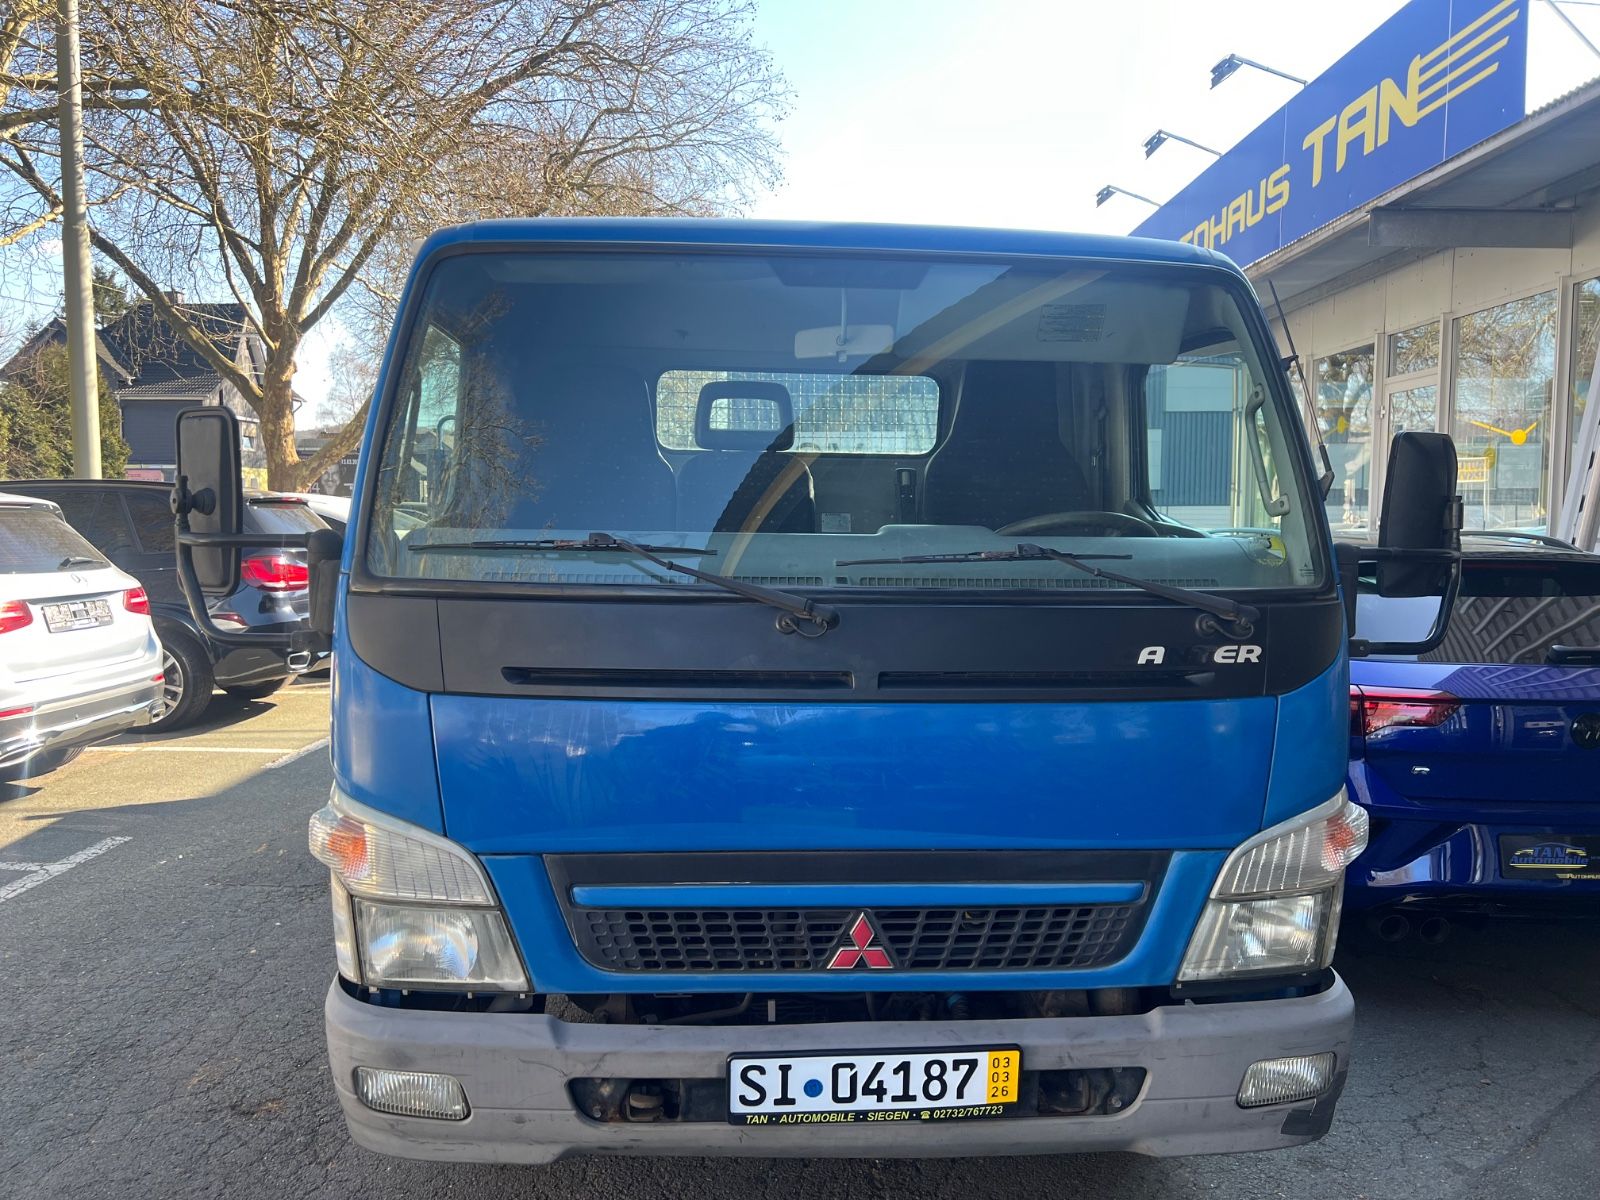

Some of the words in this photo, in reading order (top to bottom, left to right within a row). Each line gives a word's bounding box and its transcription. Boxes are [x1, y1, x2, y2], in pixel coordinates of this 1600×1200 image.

[1532, 846, 1566, 858] TAN
[992, 1056, 1010, 1069] 03
[738, 1063, 796, 1107] SI
[831, 1057, 979, 1104] 04187
[991, 1071, 1009, 1083] 03
[991, 1085, 1009, 1098] 26
[745, 1114, 769, 1124] TAN
[779, 1112, 856, 1123] AUTOMOBILE
[867, 1111, 910, 1121] SIEGEN
[933, 1105, 1004, 1119] 02732/767723
